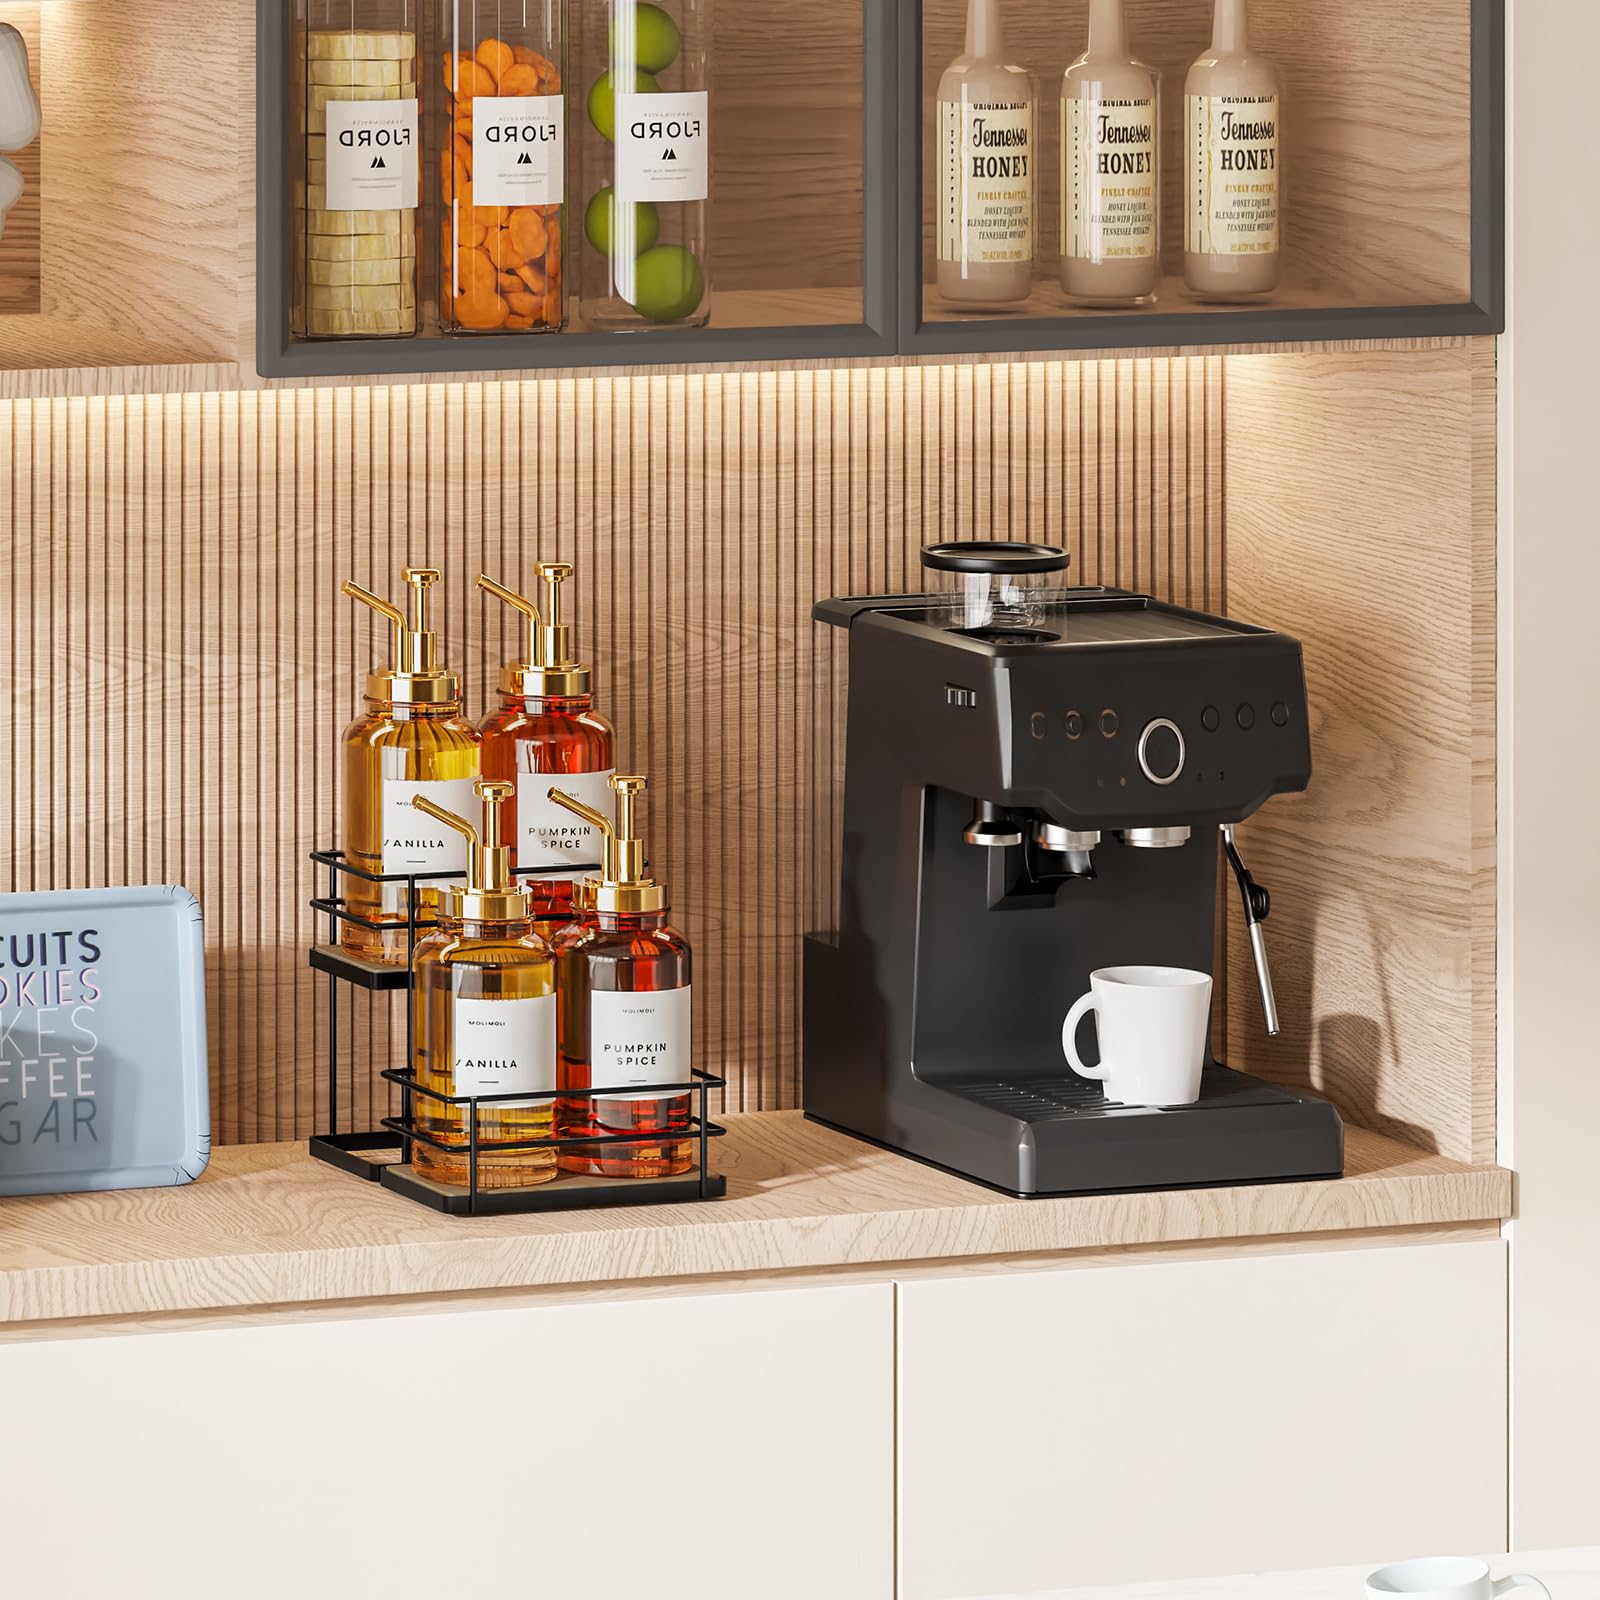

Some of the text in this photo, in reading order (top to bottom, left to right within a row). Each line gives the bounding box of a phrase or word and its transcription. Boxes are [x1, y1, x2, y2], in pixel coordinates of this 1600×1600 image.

[972, 155, 1028, 178] HONEY
[1096, 152, 1151, 174] HONEY
[1220, 148, 1275, 171] HONEY
[528, 826, 591, 836] PUMPKIN
[541, 839, 580, 849] SPICE
[0, 929, 101, 968] UITS
[604, 1042, 667, 1053] PUMPKIN
[617, 1055, 656, 1065] SPICE
